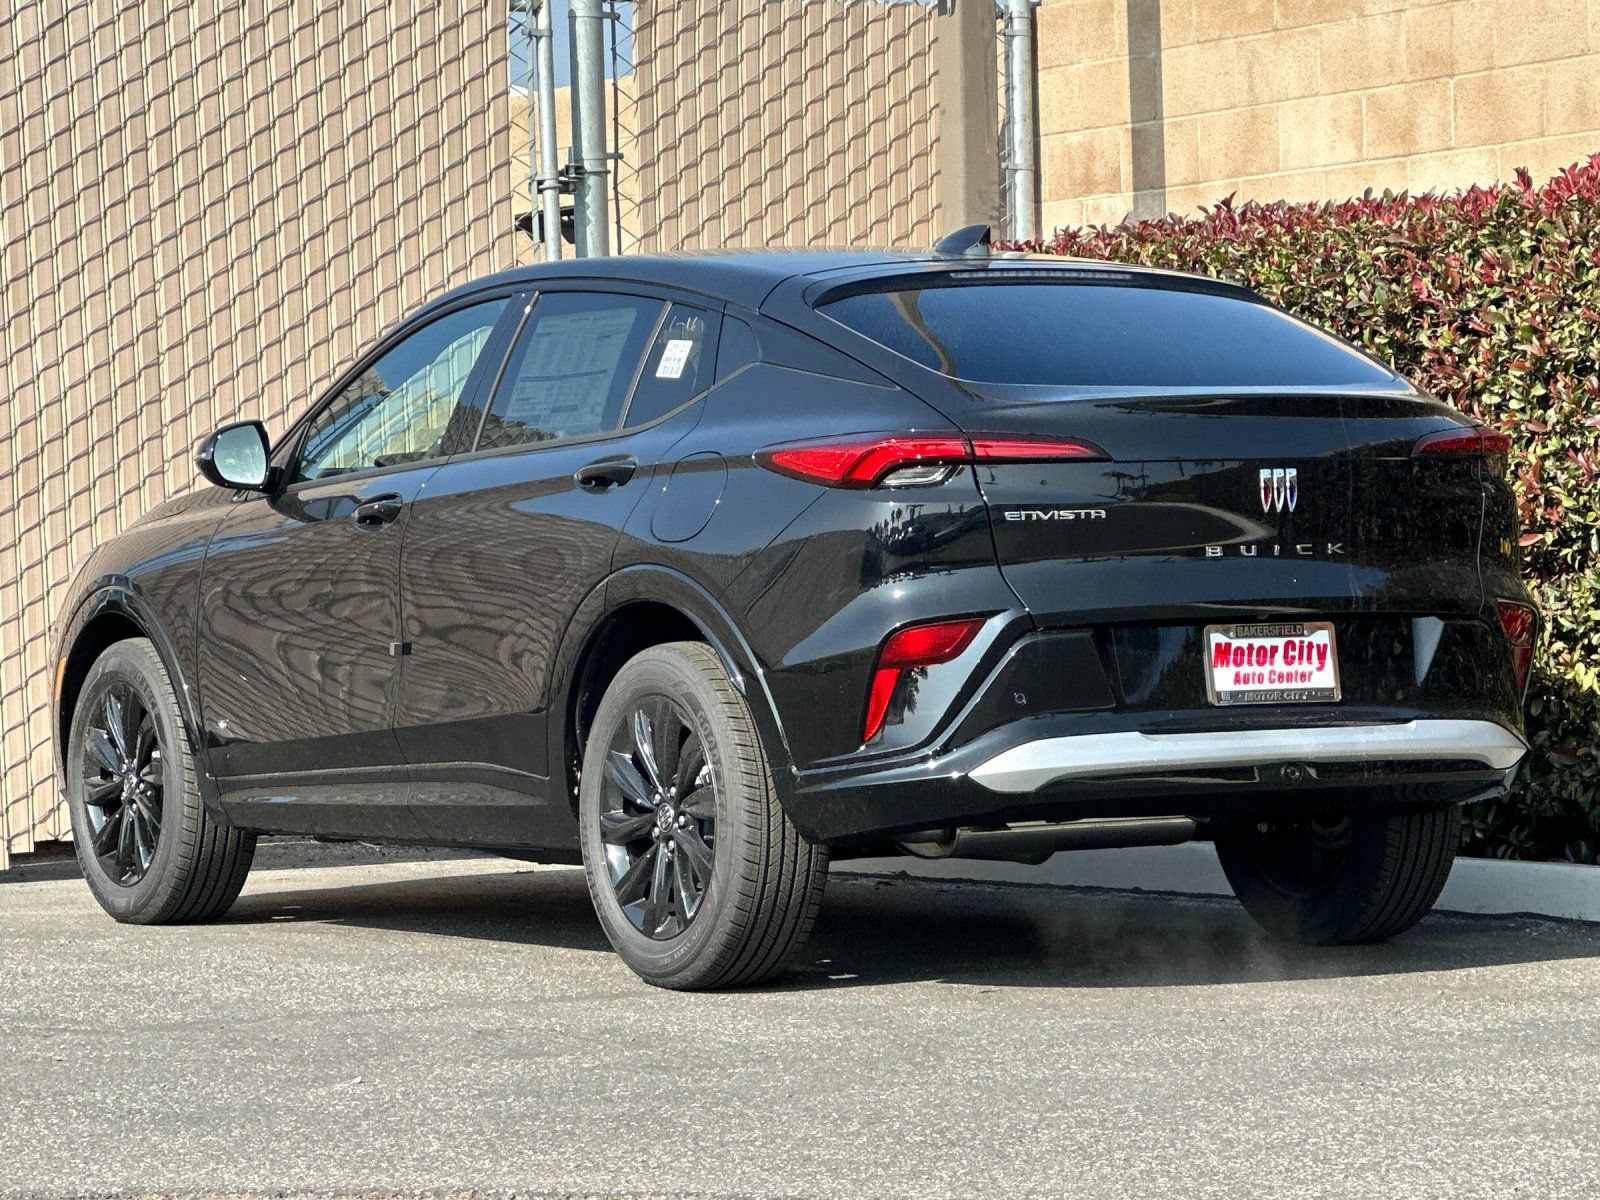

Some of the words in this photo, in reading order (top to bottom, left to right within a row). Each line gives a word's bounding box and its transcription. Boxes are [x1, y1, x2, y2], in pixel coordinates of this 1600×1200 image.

[1004, 508, 1107, 521] ENVISTA
[1205, 542, 1345, 557] BUICK
[1238, 625, 1302, 637] BAKERSFIELD
[1213, 641, 1278, 668] Motor
[1283, 640, 1328, 671] City
[1233, 671, 1264, 685] Auto
[1268, 669, 1313, 684] Center
[1244, 691, 1281, 701] MOTOR
